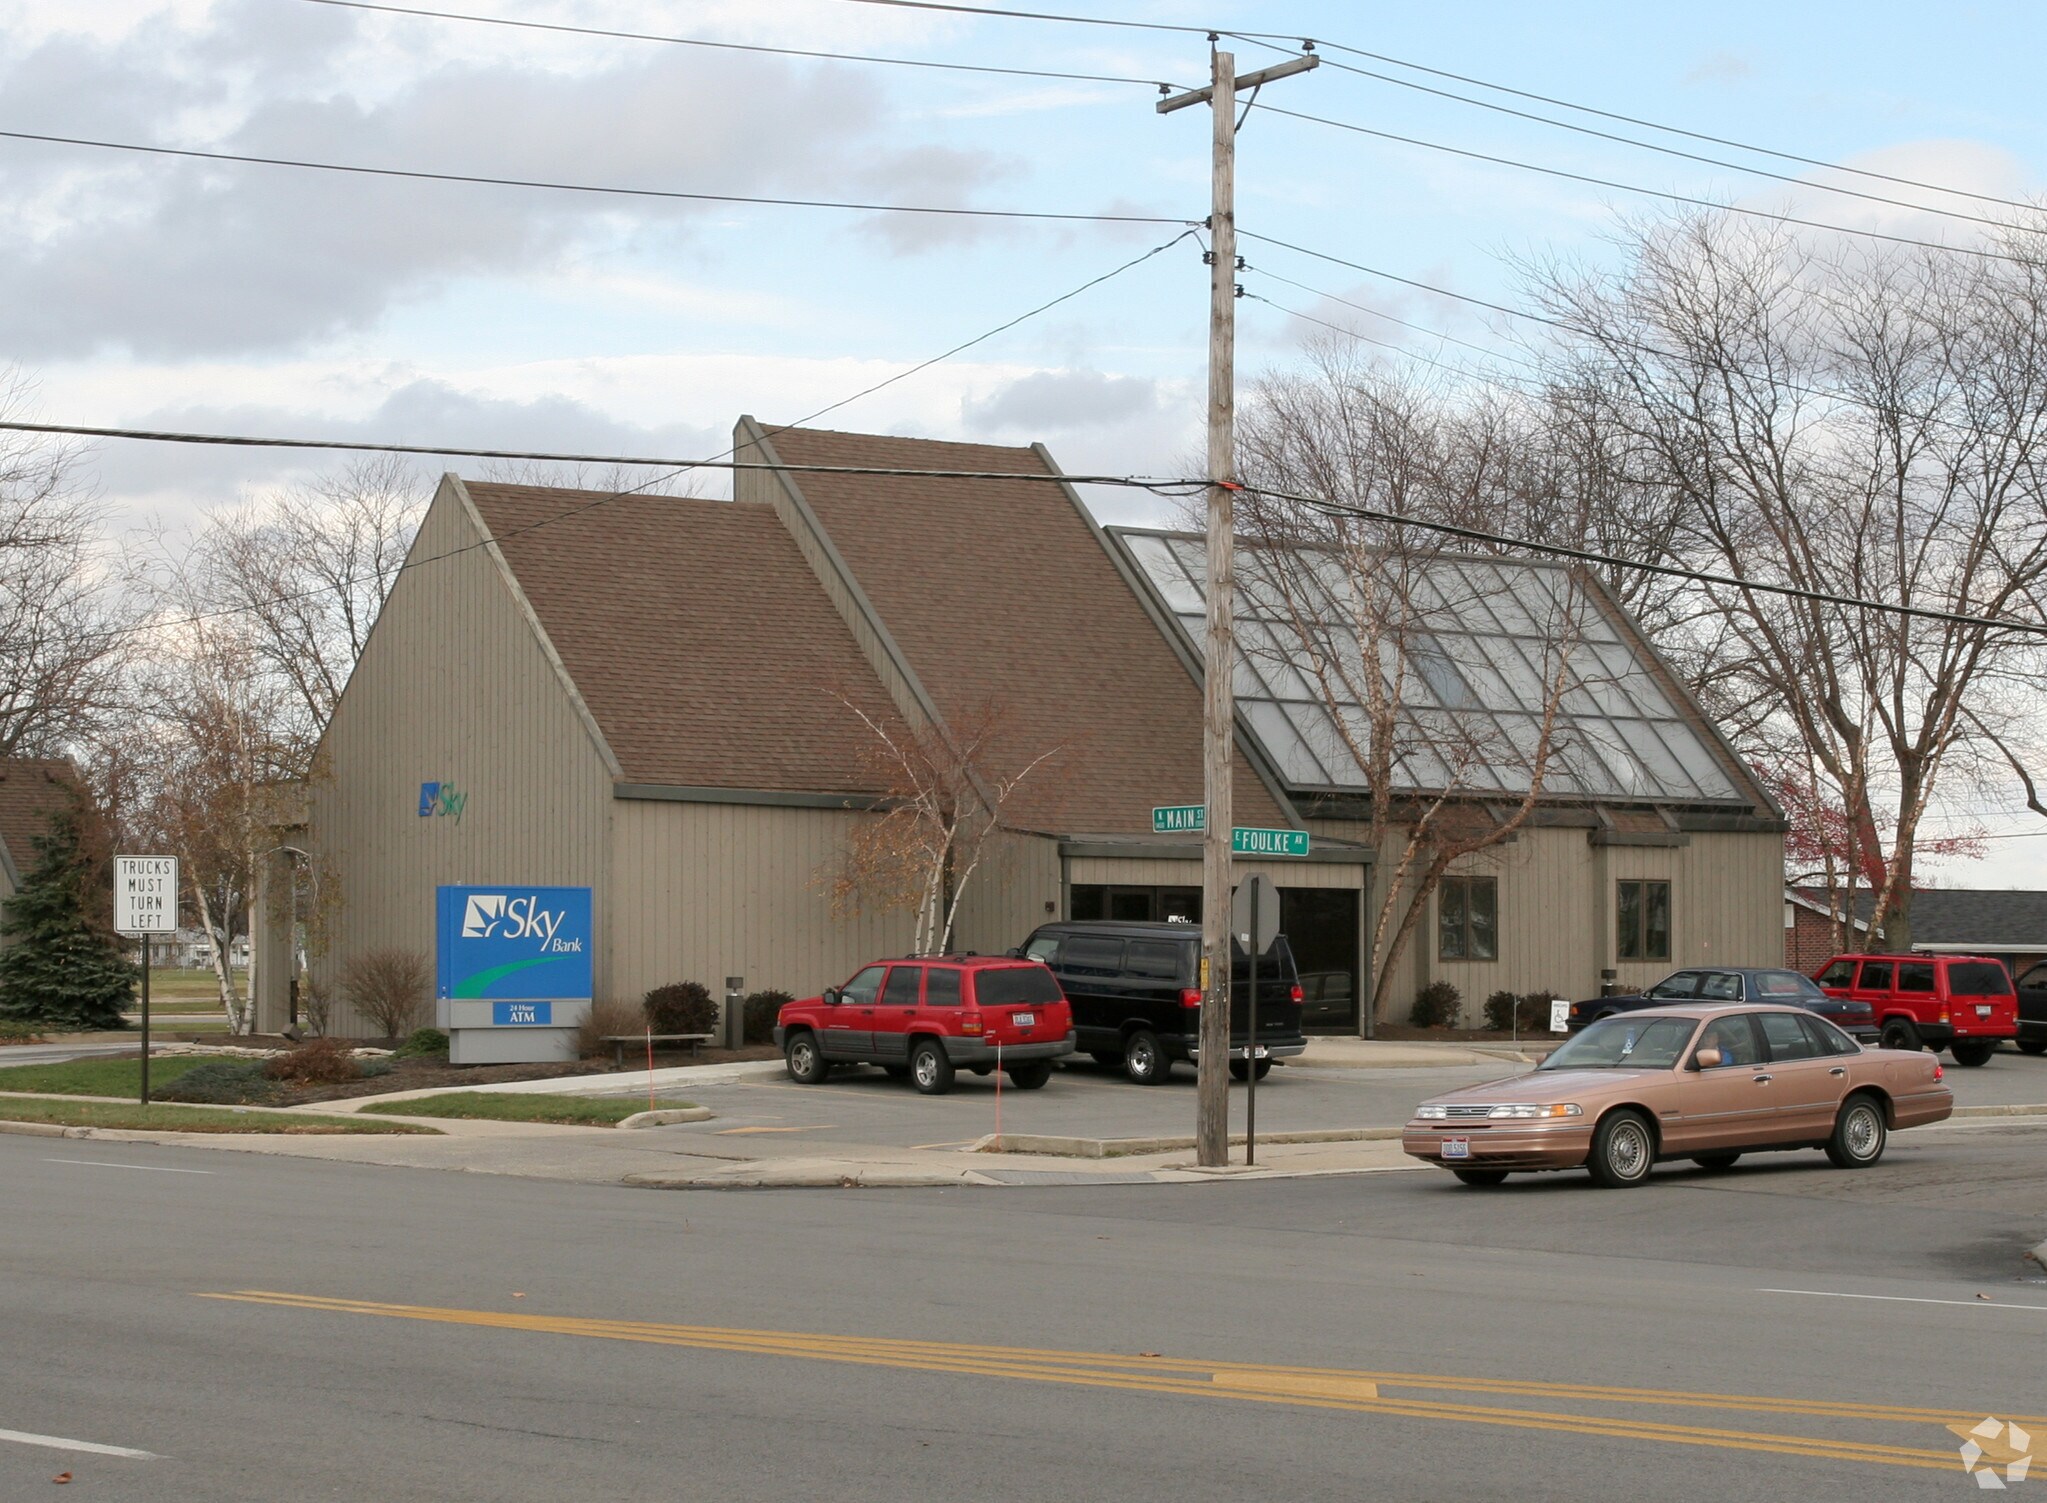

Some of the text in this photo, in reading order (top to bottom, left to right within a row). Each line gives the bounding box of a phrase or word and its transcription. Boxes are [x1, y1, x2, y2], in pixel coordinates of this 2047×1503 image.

[438, 781, 468, 826] Sky
[1166, 809, 1195, 828] MAIN
[1197, 809, 1204, 819] ST
[1235, 831, 1240, 841] E
[1242, 831, 1290, 852] FOULKE
[122, 860, 170, 875] TRUCKS
[128, 878, 163, 892] MUST
[130, 896, 162, 910] TURN
[131, 914, 162, 928] LEFT
[503, 895, 566, 952] Sky
[552, 937, 582, 952] Bank
[518, 1004, 536, 1012] Hour
[509, 1011, 536, 1023] ATM
